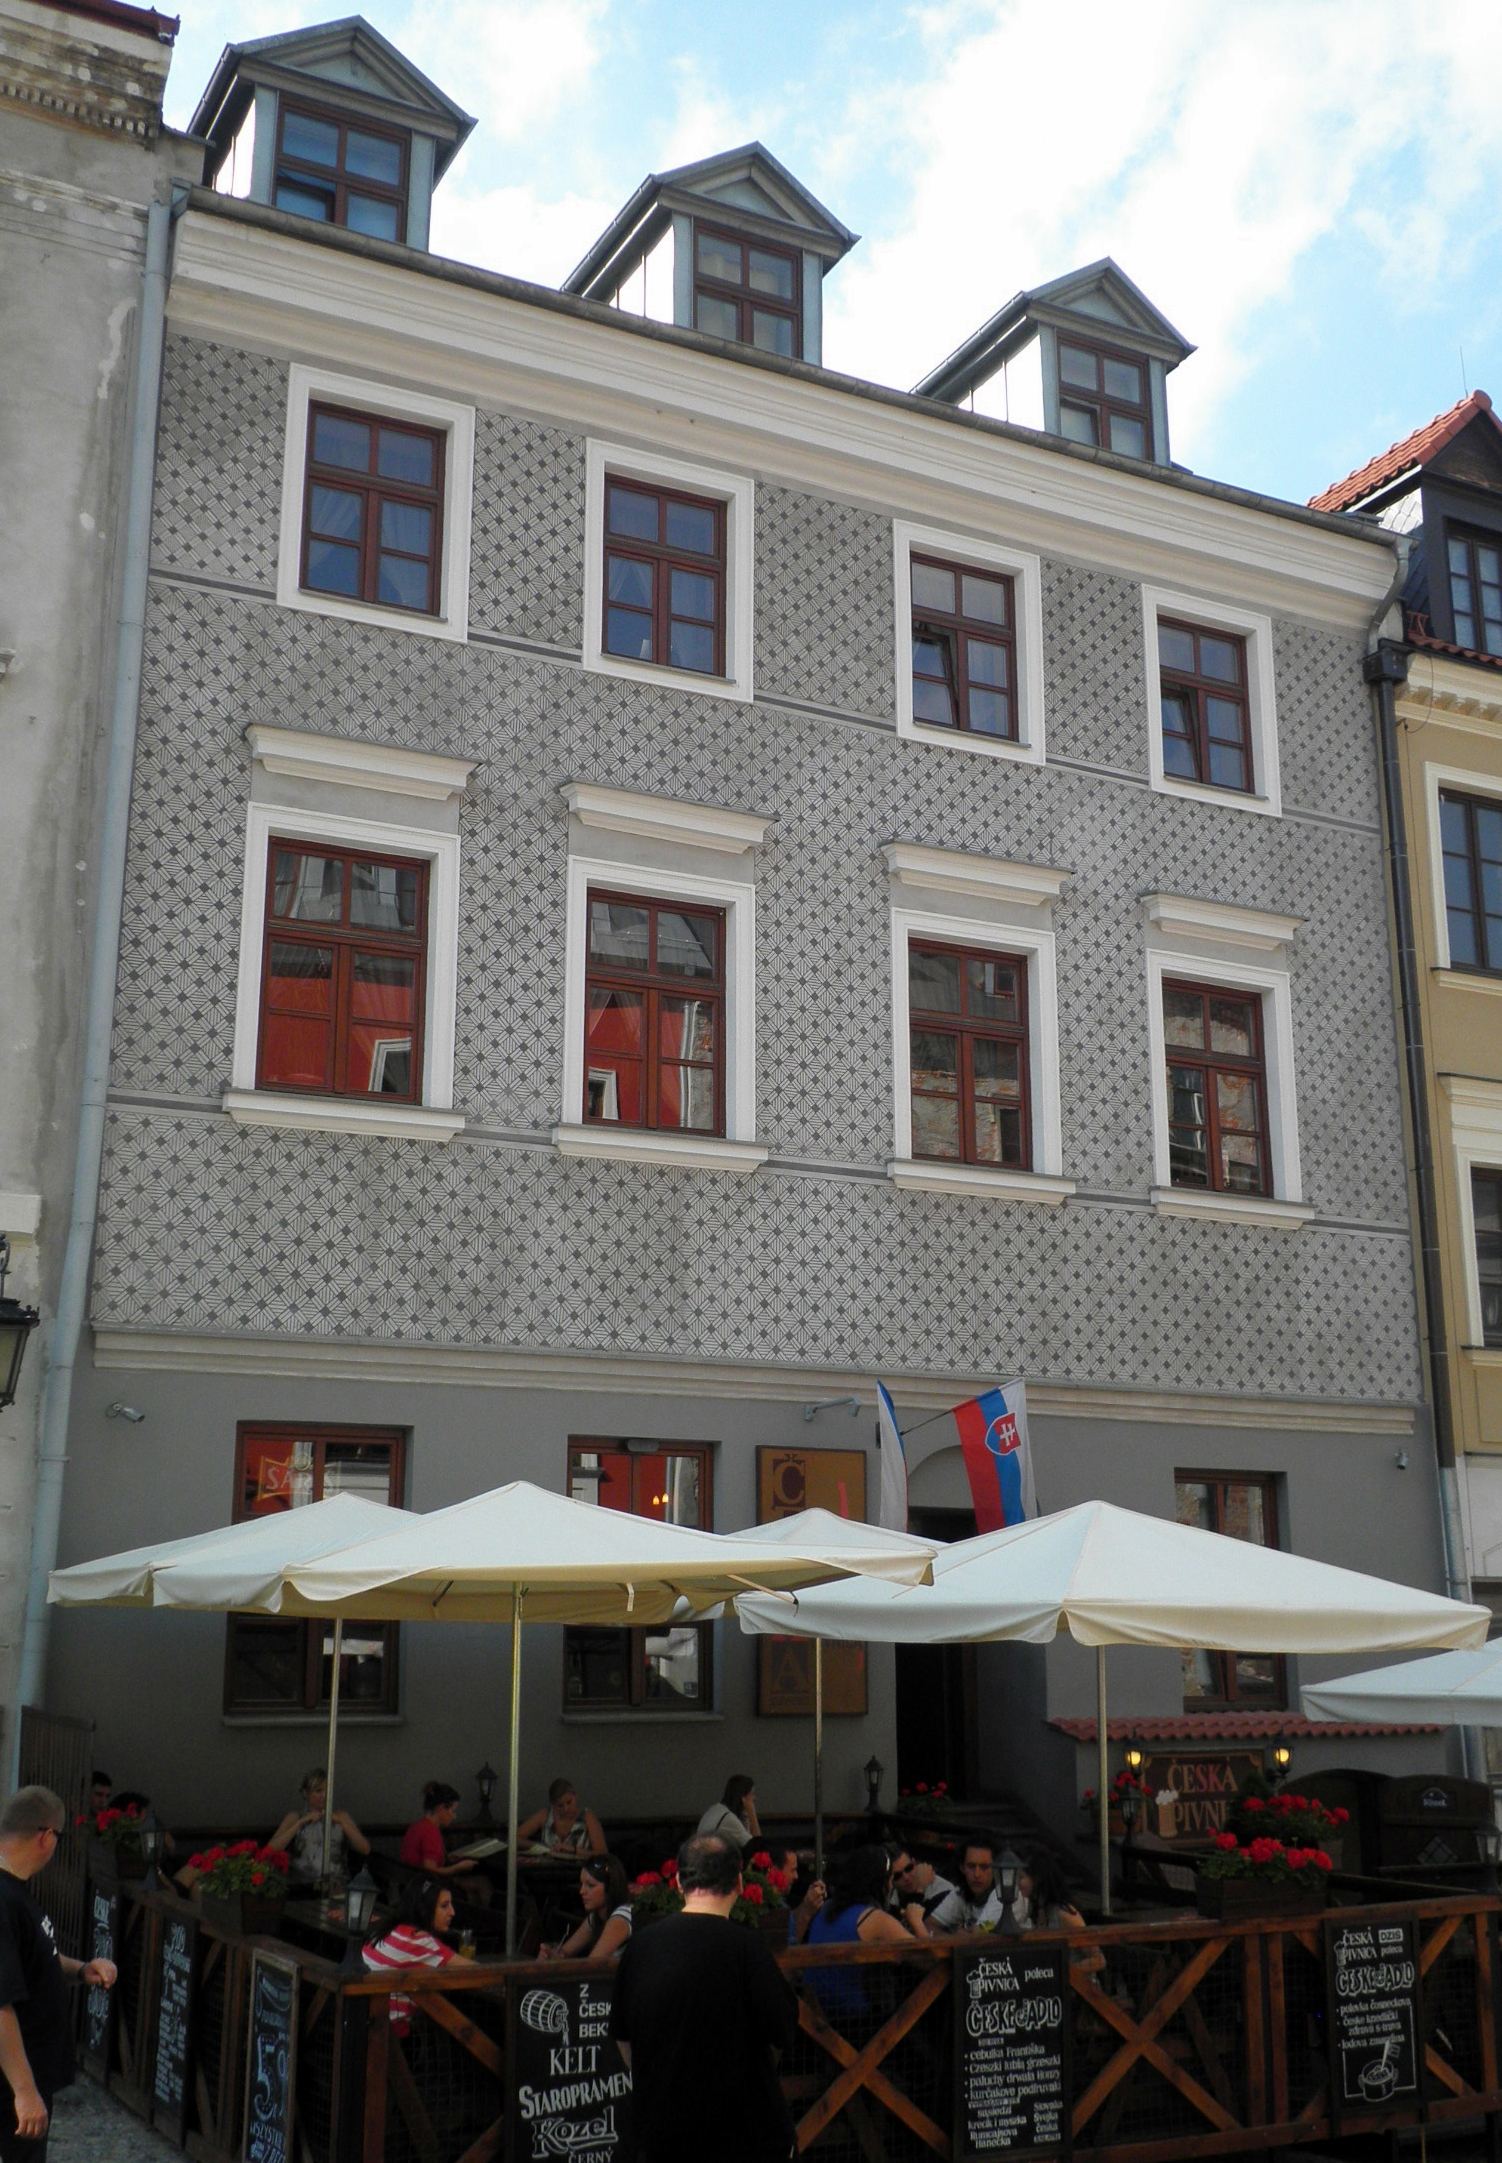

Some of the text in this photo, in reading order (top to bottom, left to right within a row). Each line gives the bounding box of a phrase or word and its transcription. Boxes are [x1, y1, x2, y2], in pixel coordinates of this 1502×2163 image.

[1174, 1800, 1230, 1832] PIVNI
[1344, 1946, 1377, 1961] PIVNICA
[978, 1956, 1055, 1982] ČESKÁ poleca
[579, 1983, 590, 1998] Z
[979, 1977, 1020, 1992] PIVNICA
[550, 2045, 602, 2077] KELT
[519, 2069, 633, 2120] STAROPRAMEN
[531, 2104, 619, 2159] Kozel
